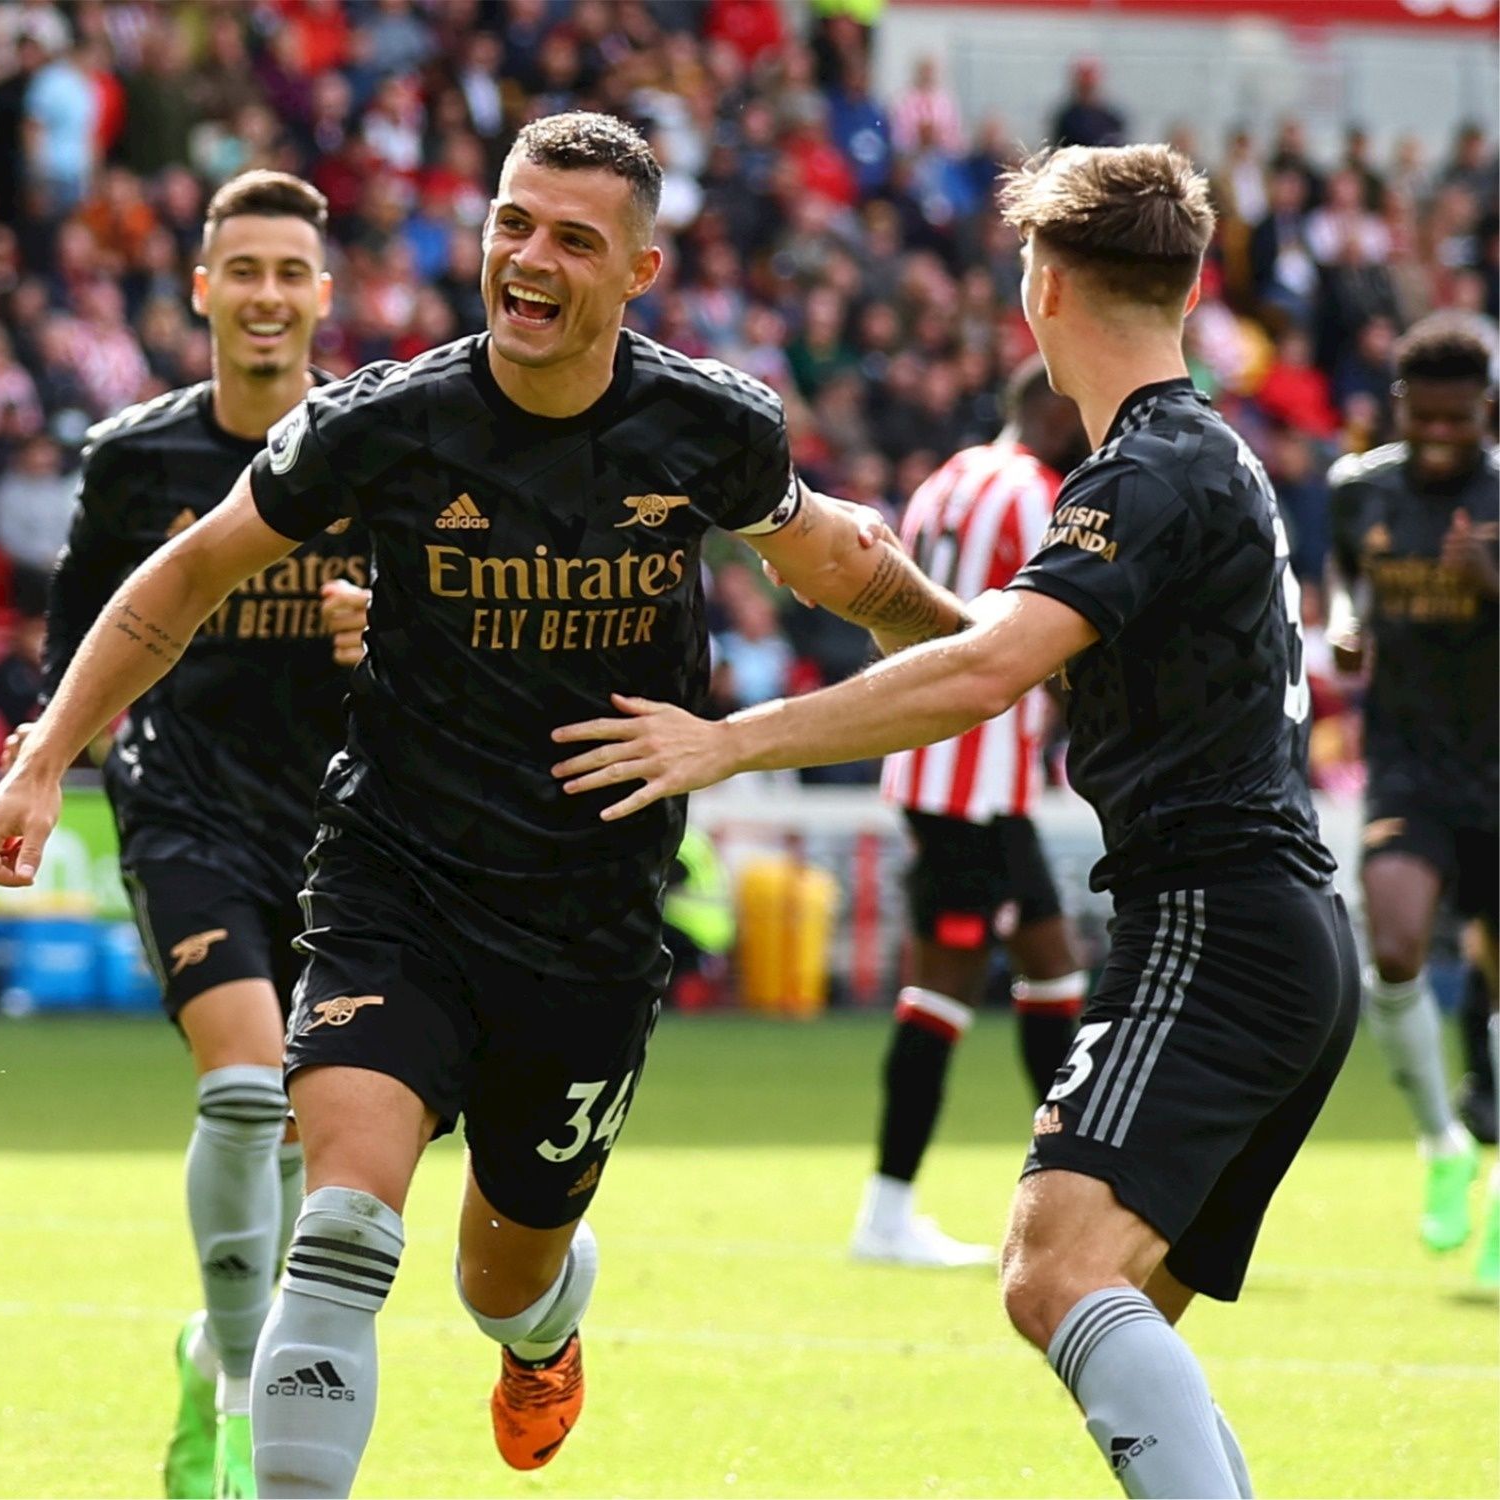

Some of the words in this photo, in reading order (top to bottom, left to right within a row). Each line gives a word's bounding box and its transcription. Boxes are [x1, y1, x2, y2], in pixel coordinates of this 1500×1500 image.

[435, 516, 490, 529] adidas
[1056, 507, 1111, 531] VISIT
[424, 544, 685, 600] Emirates
[471, 608, 528, 650] FLY
[539, 606, 657, 650] BETTER
[1046, 1021, 1113, 1101] 3
[535, 1069, 634, 1163] 34
[266, 1381, 356, 1402] adidas
